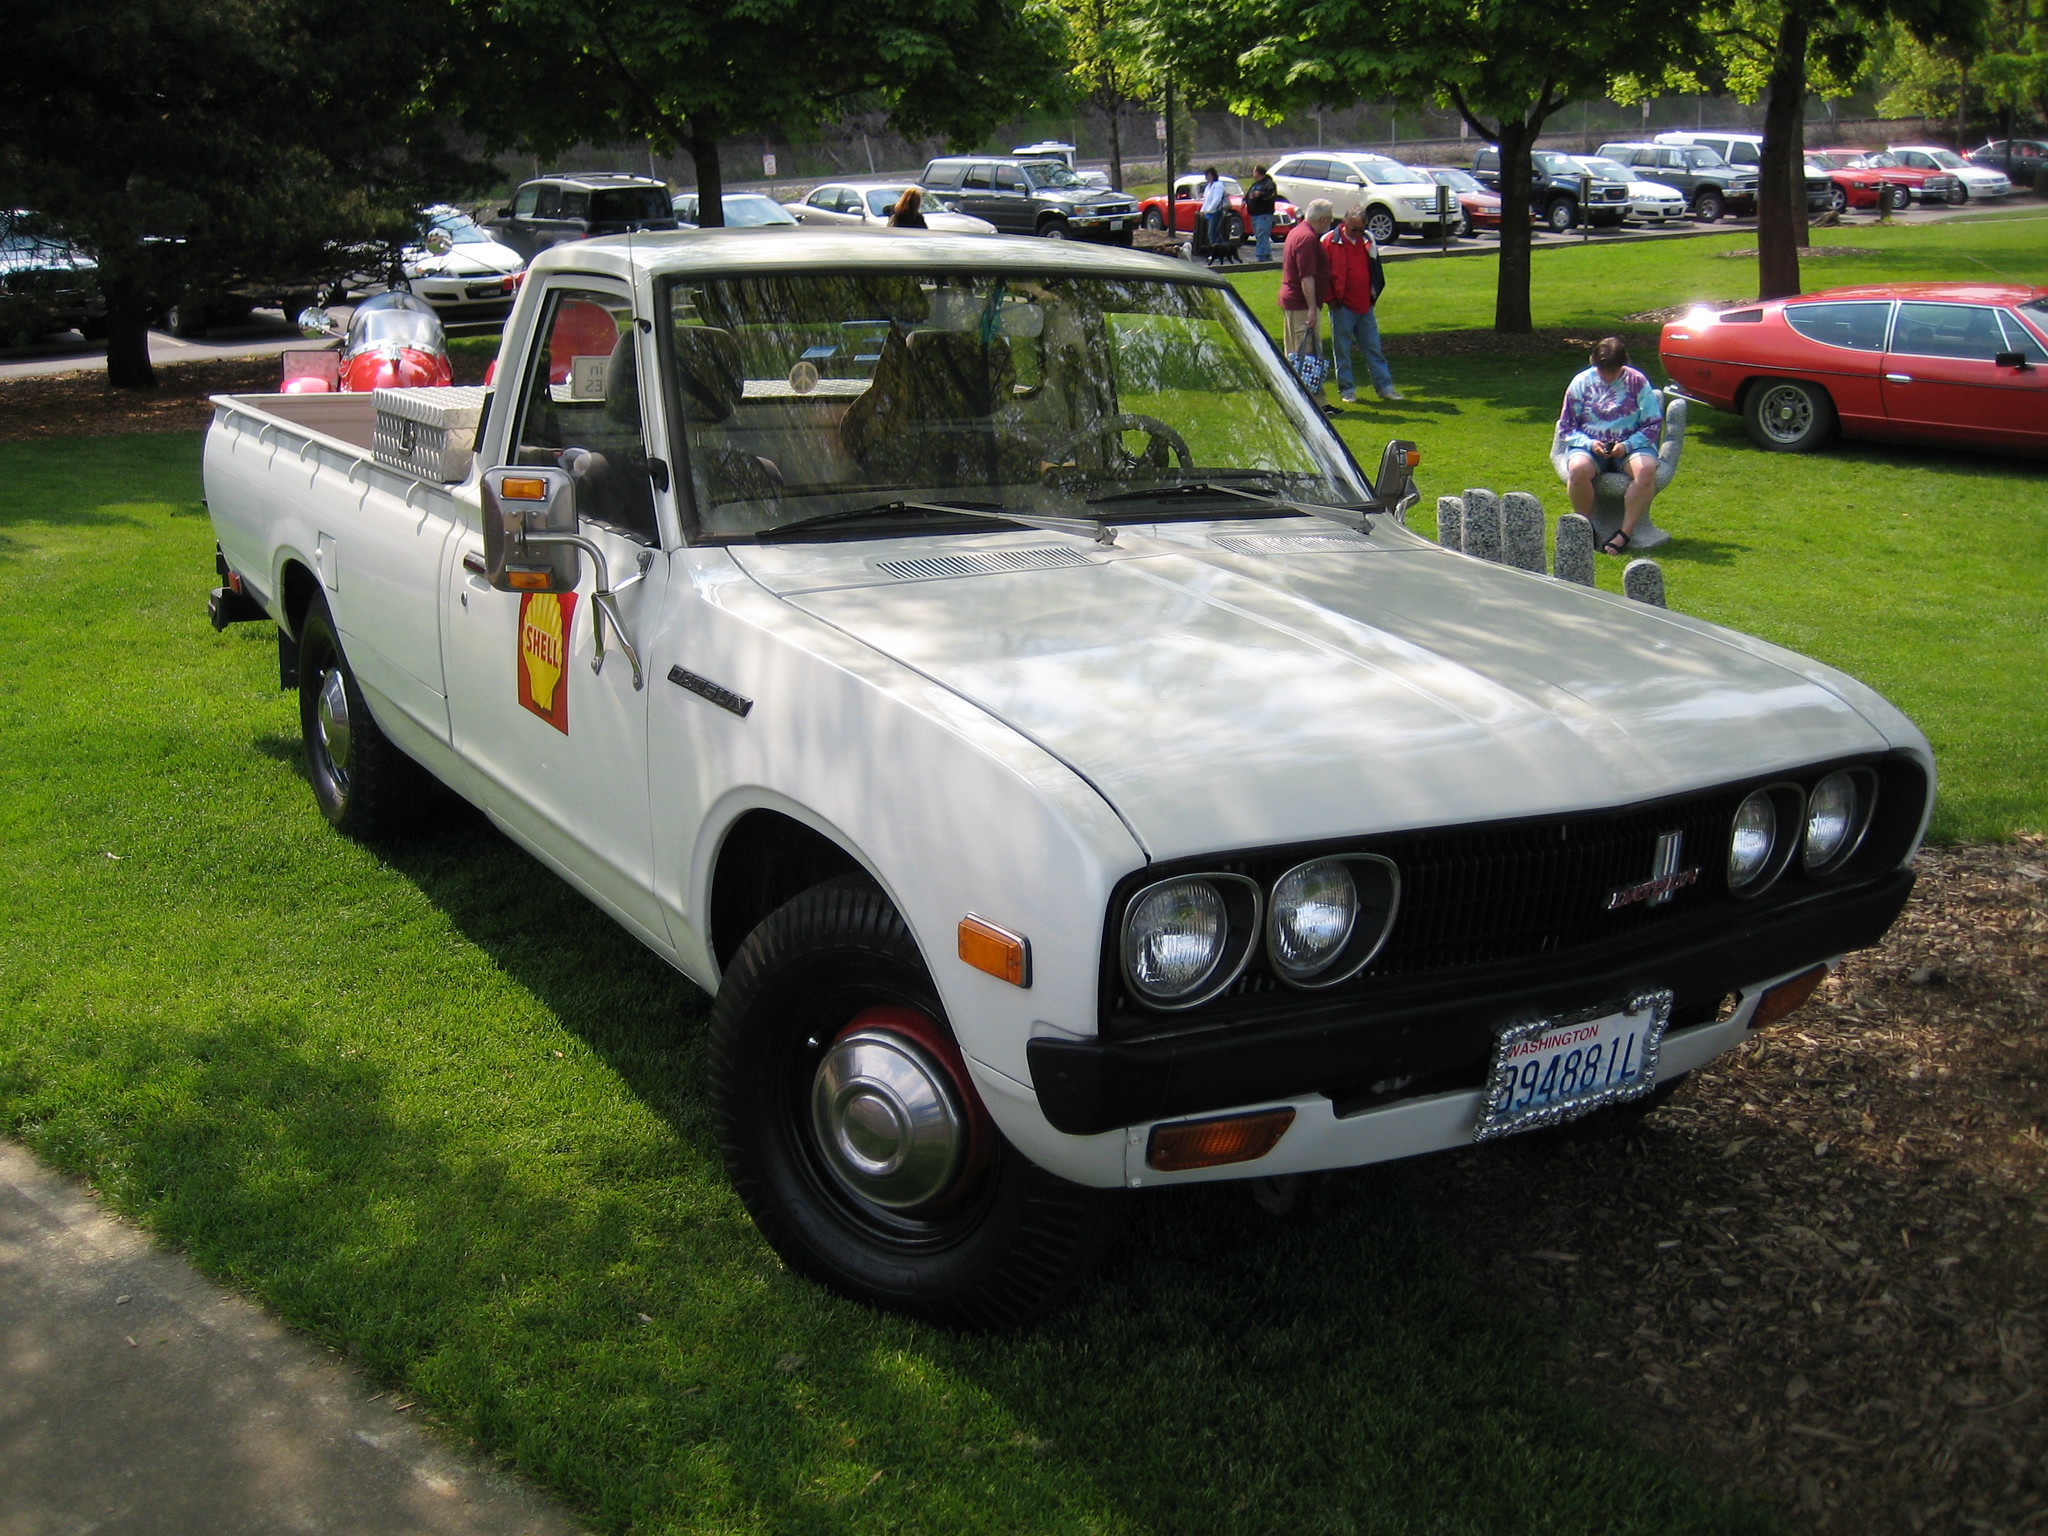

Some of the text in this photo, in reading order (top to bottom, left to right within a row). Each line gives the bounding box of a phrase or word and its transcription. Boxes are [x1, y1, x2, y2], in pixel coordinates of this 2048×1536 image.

[526, 623, 558, 668] SHELL
[669, 668, 748, 714] DATSUN
[1507, 1025, 1600, 1058] WASHINGTON
